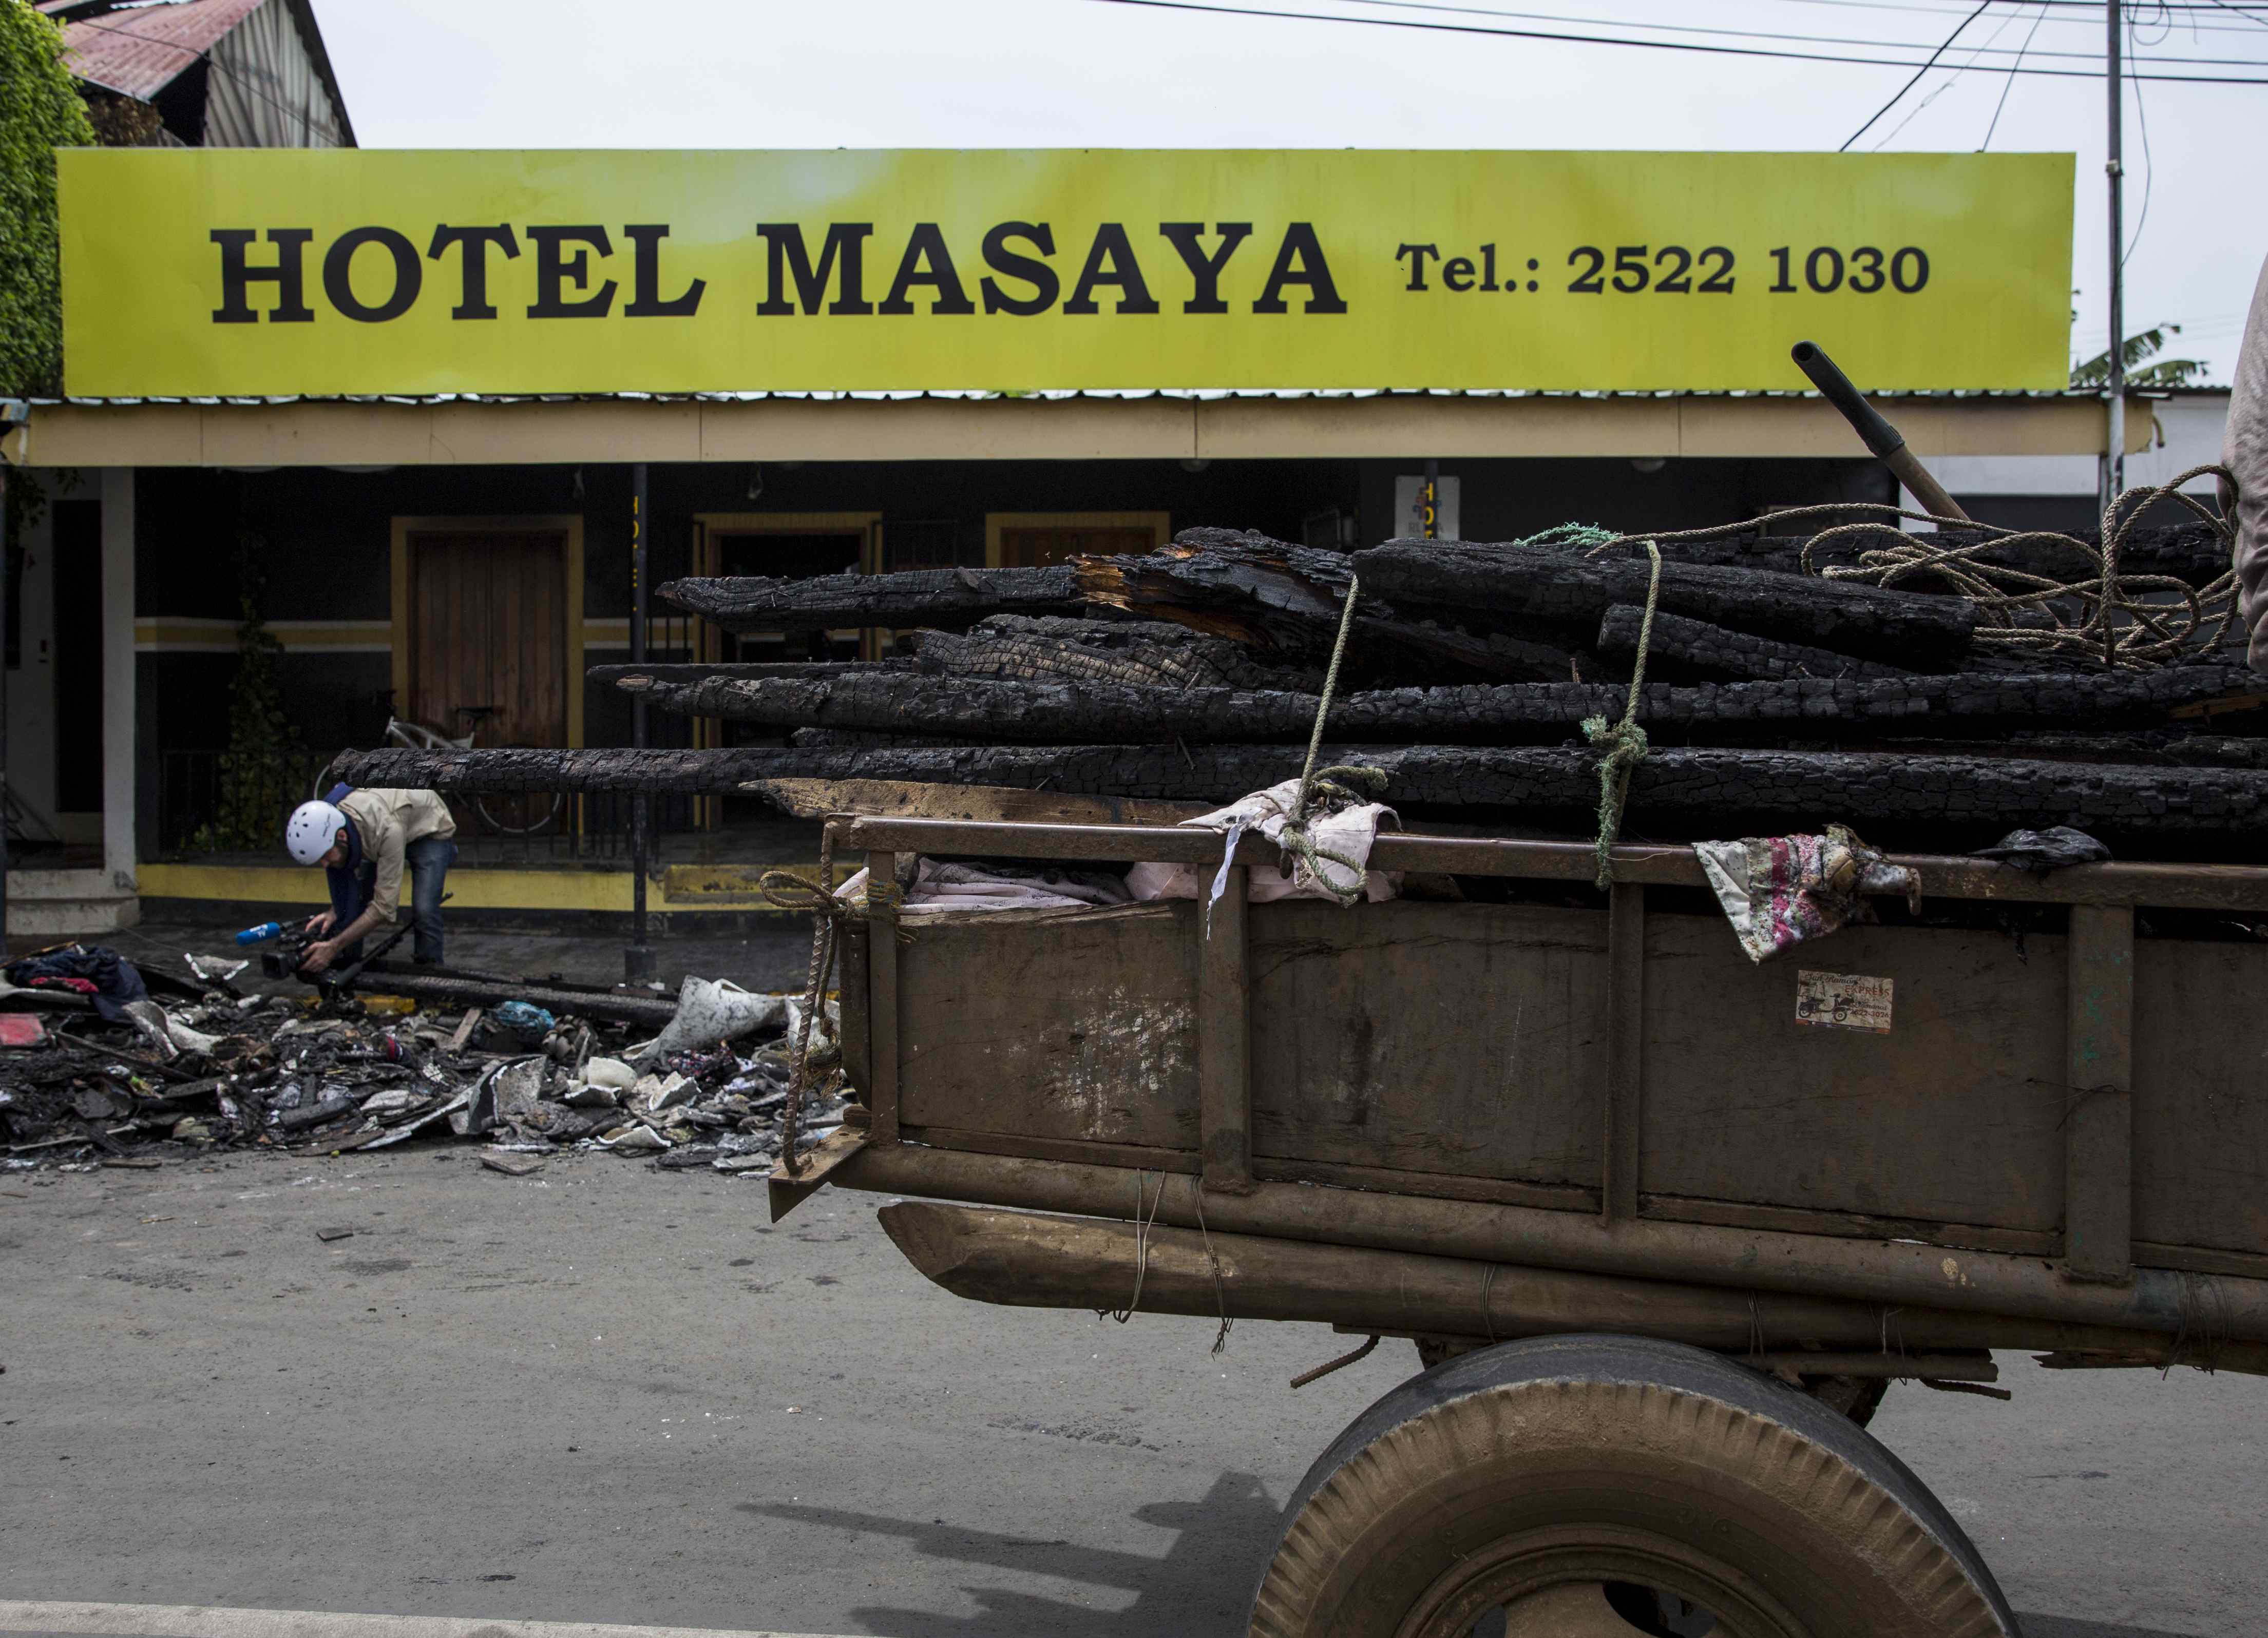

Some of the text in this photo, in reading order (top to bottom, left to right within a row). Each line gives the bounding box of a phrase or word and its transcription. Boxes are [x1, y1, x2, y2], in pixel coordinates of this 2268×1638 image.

[210, 221, 1930, 324] HOTEL MASAYA Tel.: 2522 1030
[1844, 985, 1890, 997] EXPRESS
